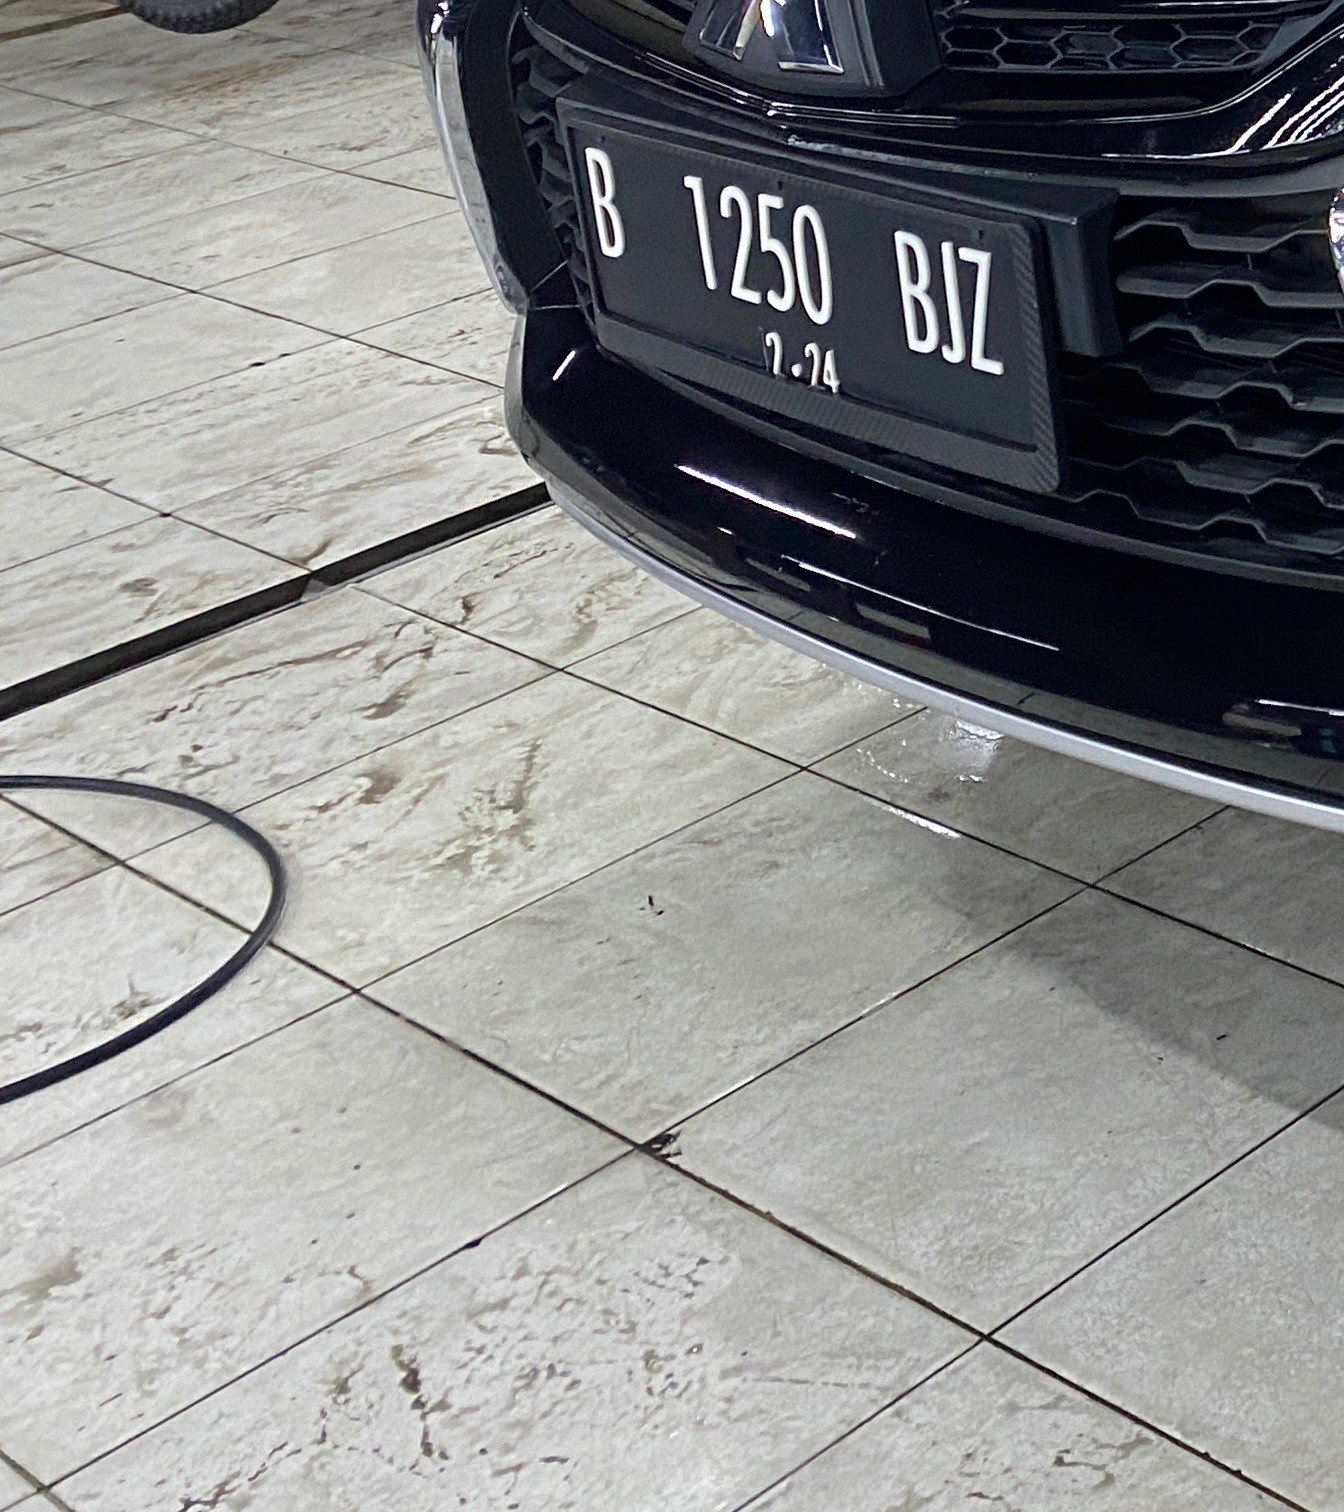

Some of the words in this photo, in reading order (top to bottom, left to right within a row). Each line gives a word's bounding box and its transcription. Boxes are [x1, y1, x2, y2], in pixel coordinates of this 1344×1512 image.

[584, 146, 625, 258] B
[682, 174, 833, 326] 1250
[893, 229, 1005, 377] BJZ
